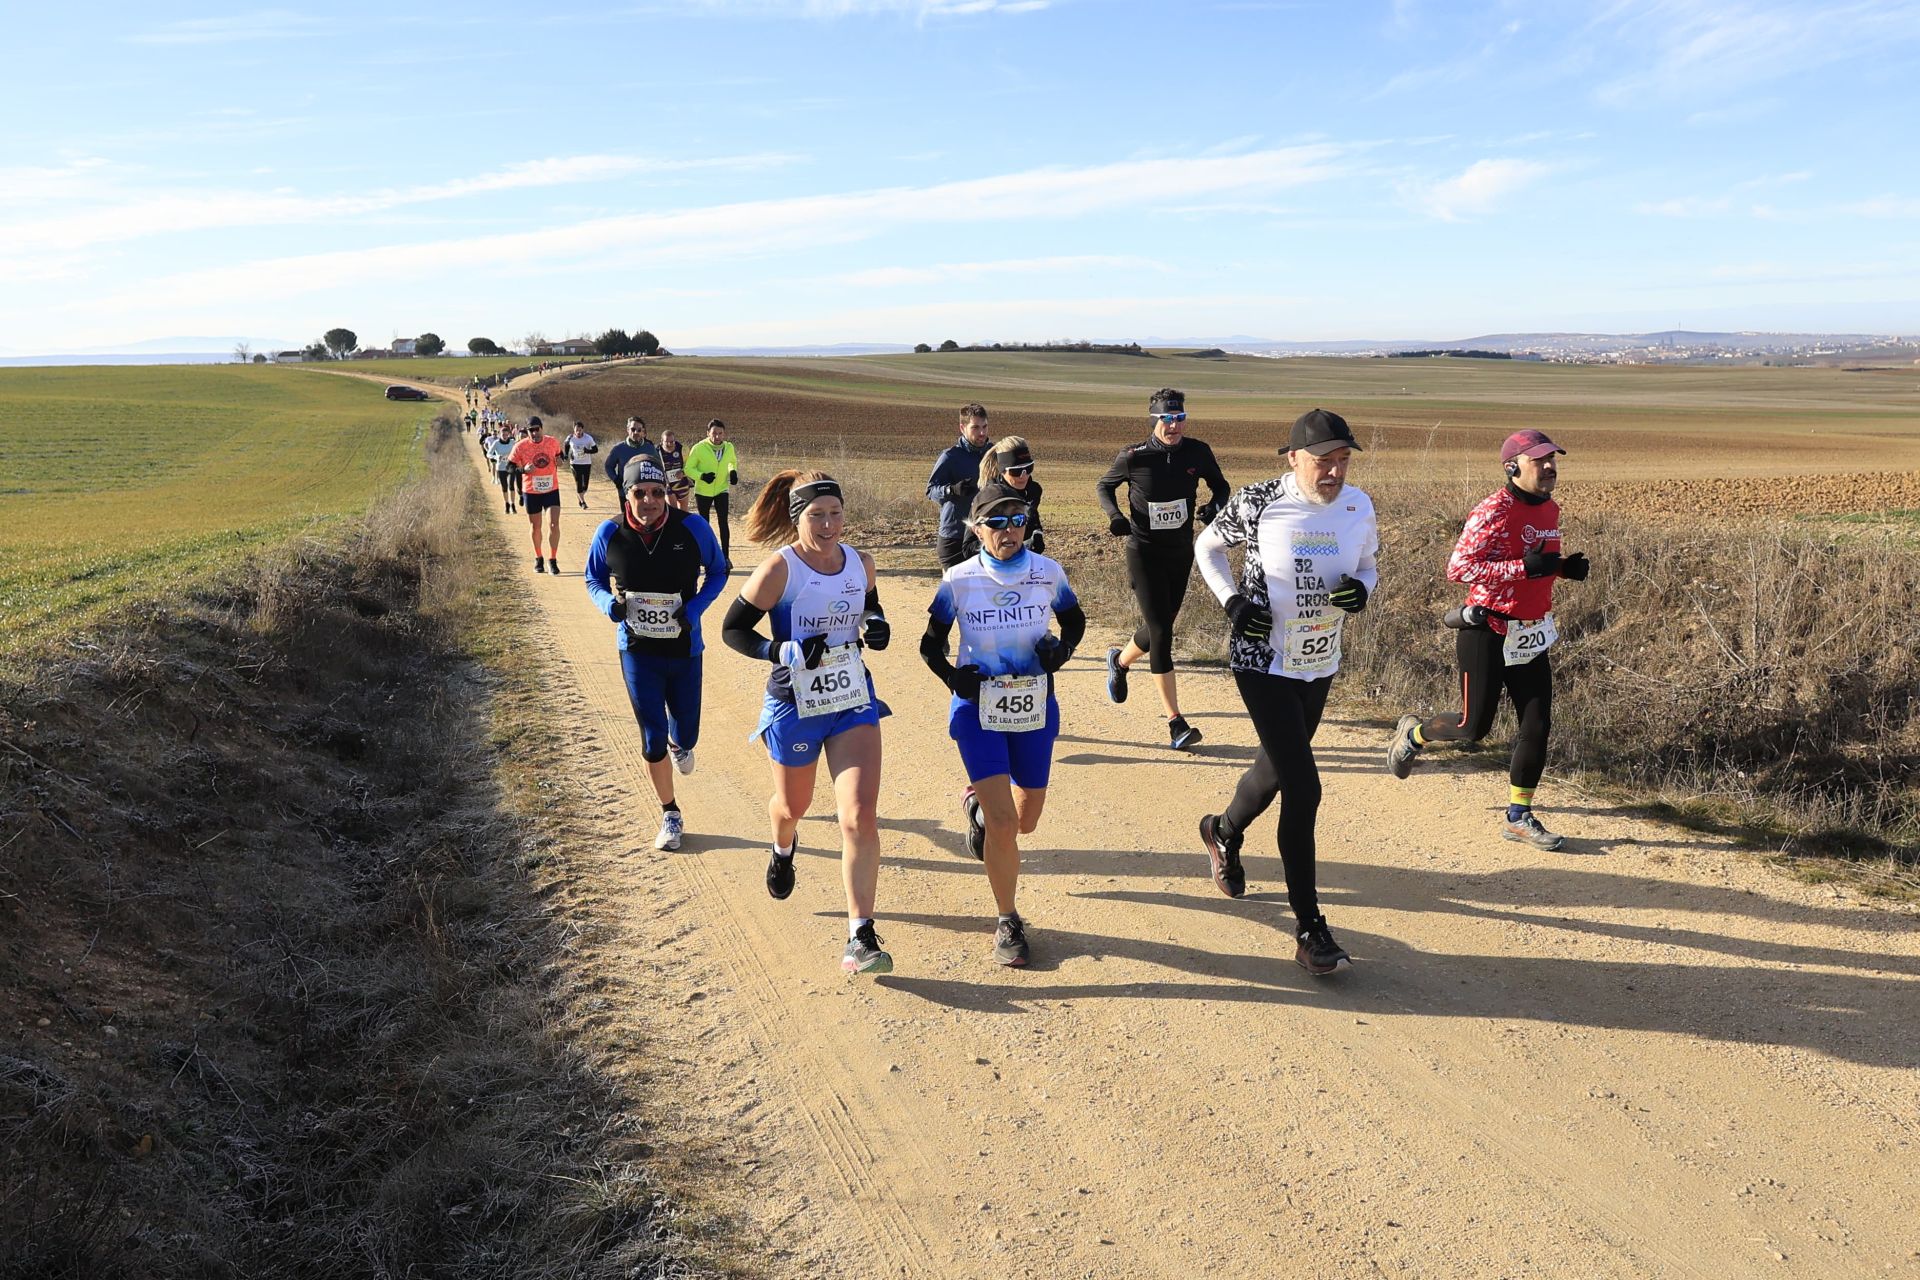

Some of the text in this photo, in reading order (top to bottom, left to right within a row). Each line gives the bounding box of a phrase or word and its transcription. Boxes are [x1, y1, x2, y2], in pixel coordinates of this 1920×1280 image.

[1157, 510, 1181, 521] 1070
[1294, 558, 1313, 573] 32
[1296, 593, 1329, 607] CROS
[637, 609, 669, 625] 383
[799, 613, 861, 628] INFINIT
[966, 605, 1047, 624] INFINITY
[1301, 631, 1337, 656] 527
[1517, 630, 1546, 649] 220
[1292, 658, 1302, 667] 32
[810, 670, 851, 694] 456
[805, 699, 817, 709] 32
[832, 694, 850, 704] CROSS
[850, 688, 862, 699] AVS
[996, 694, 1034, 713] 458
[988, 715, 998, 724] 32
[1030, 713, 1040, 722] AVS
